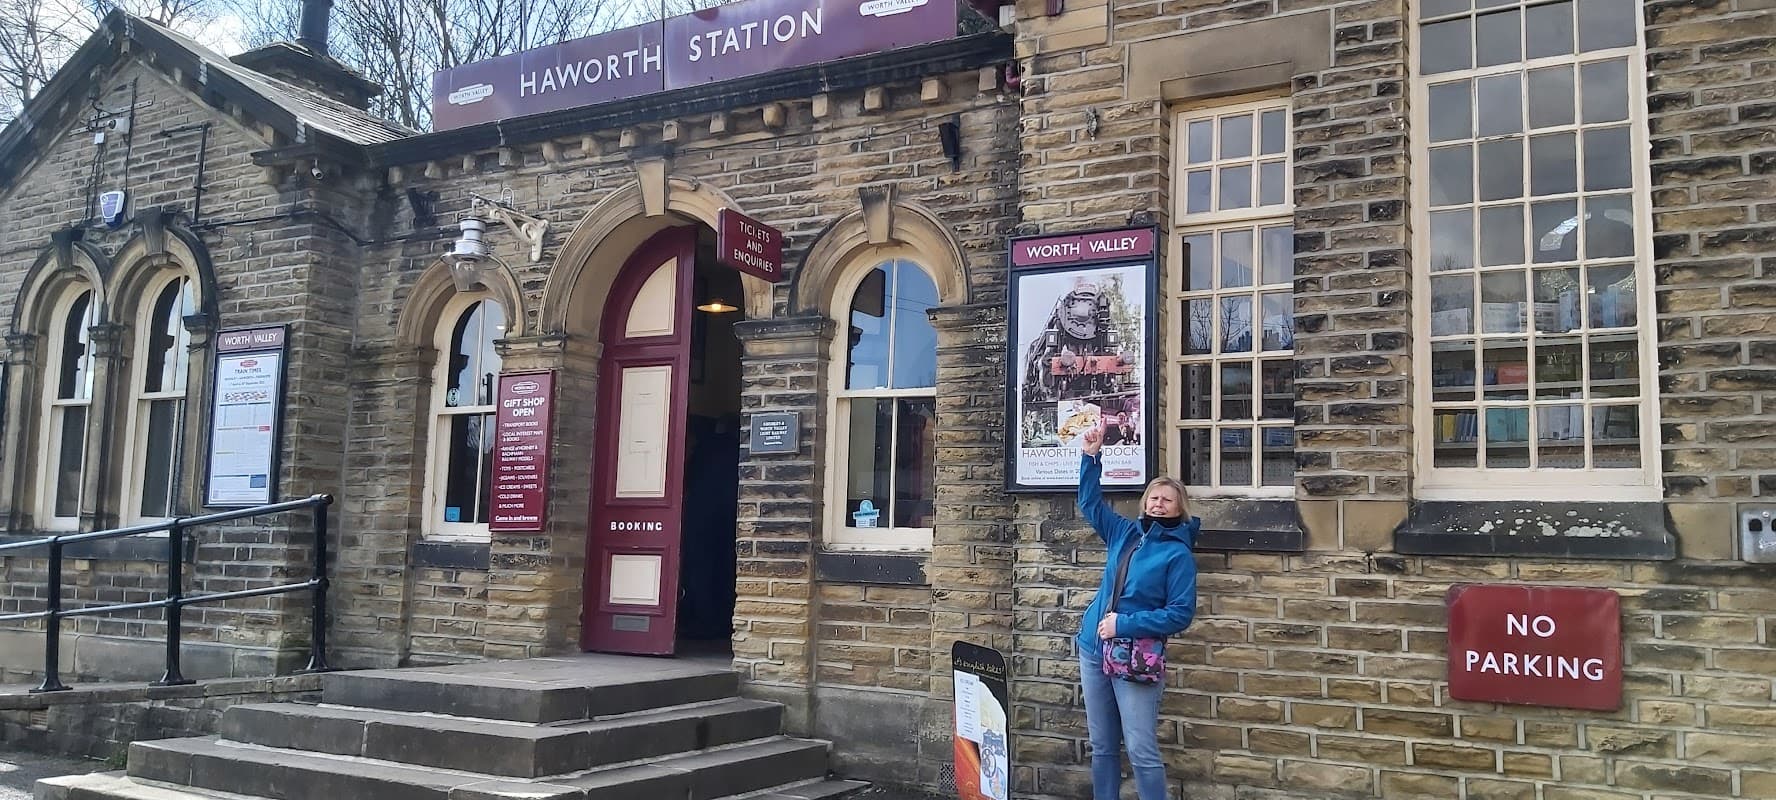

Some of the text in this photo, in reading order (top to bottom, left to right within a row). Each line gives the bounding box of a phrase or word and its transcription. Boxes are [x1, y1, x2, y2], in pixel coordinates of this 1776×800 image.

[867, 1, 893, 10] WORTH
[520, 7, 822, 98] HAWORTH STATION
[746, 239, 763, 254] AND
[1026, 236, 1138, 259] WORTH VALLEY
[733, 248, 774, 273] ENQUIRIES
[224, 332, 278, 346] WORTH VALLEY
[503, 396, 545, 408] GIFT SHOP
[512, 407, 535, 417] OPEN
[1022, 448, 1077, 458] HAWORTH
[610, 521, 663, 531] BOOKING
[1507, 613, 1556, 638] NO
[1465, 650, 1604, 681] PARKING
